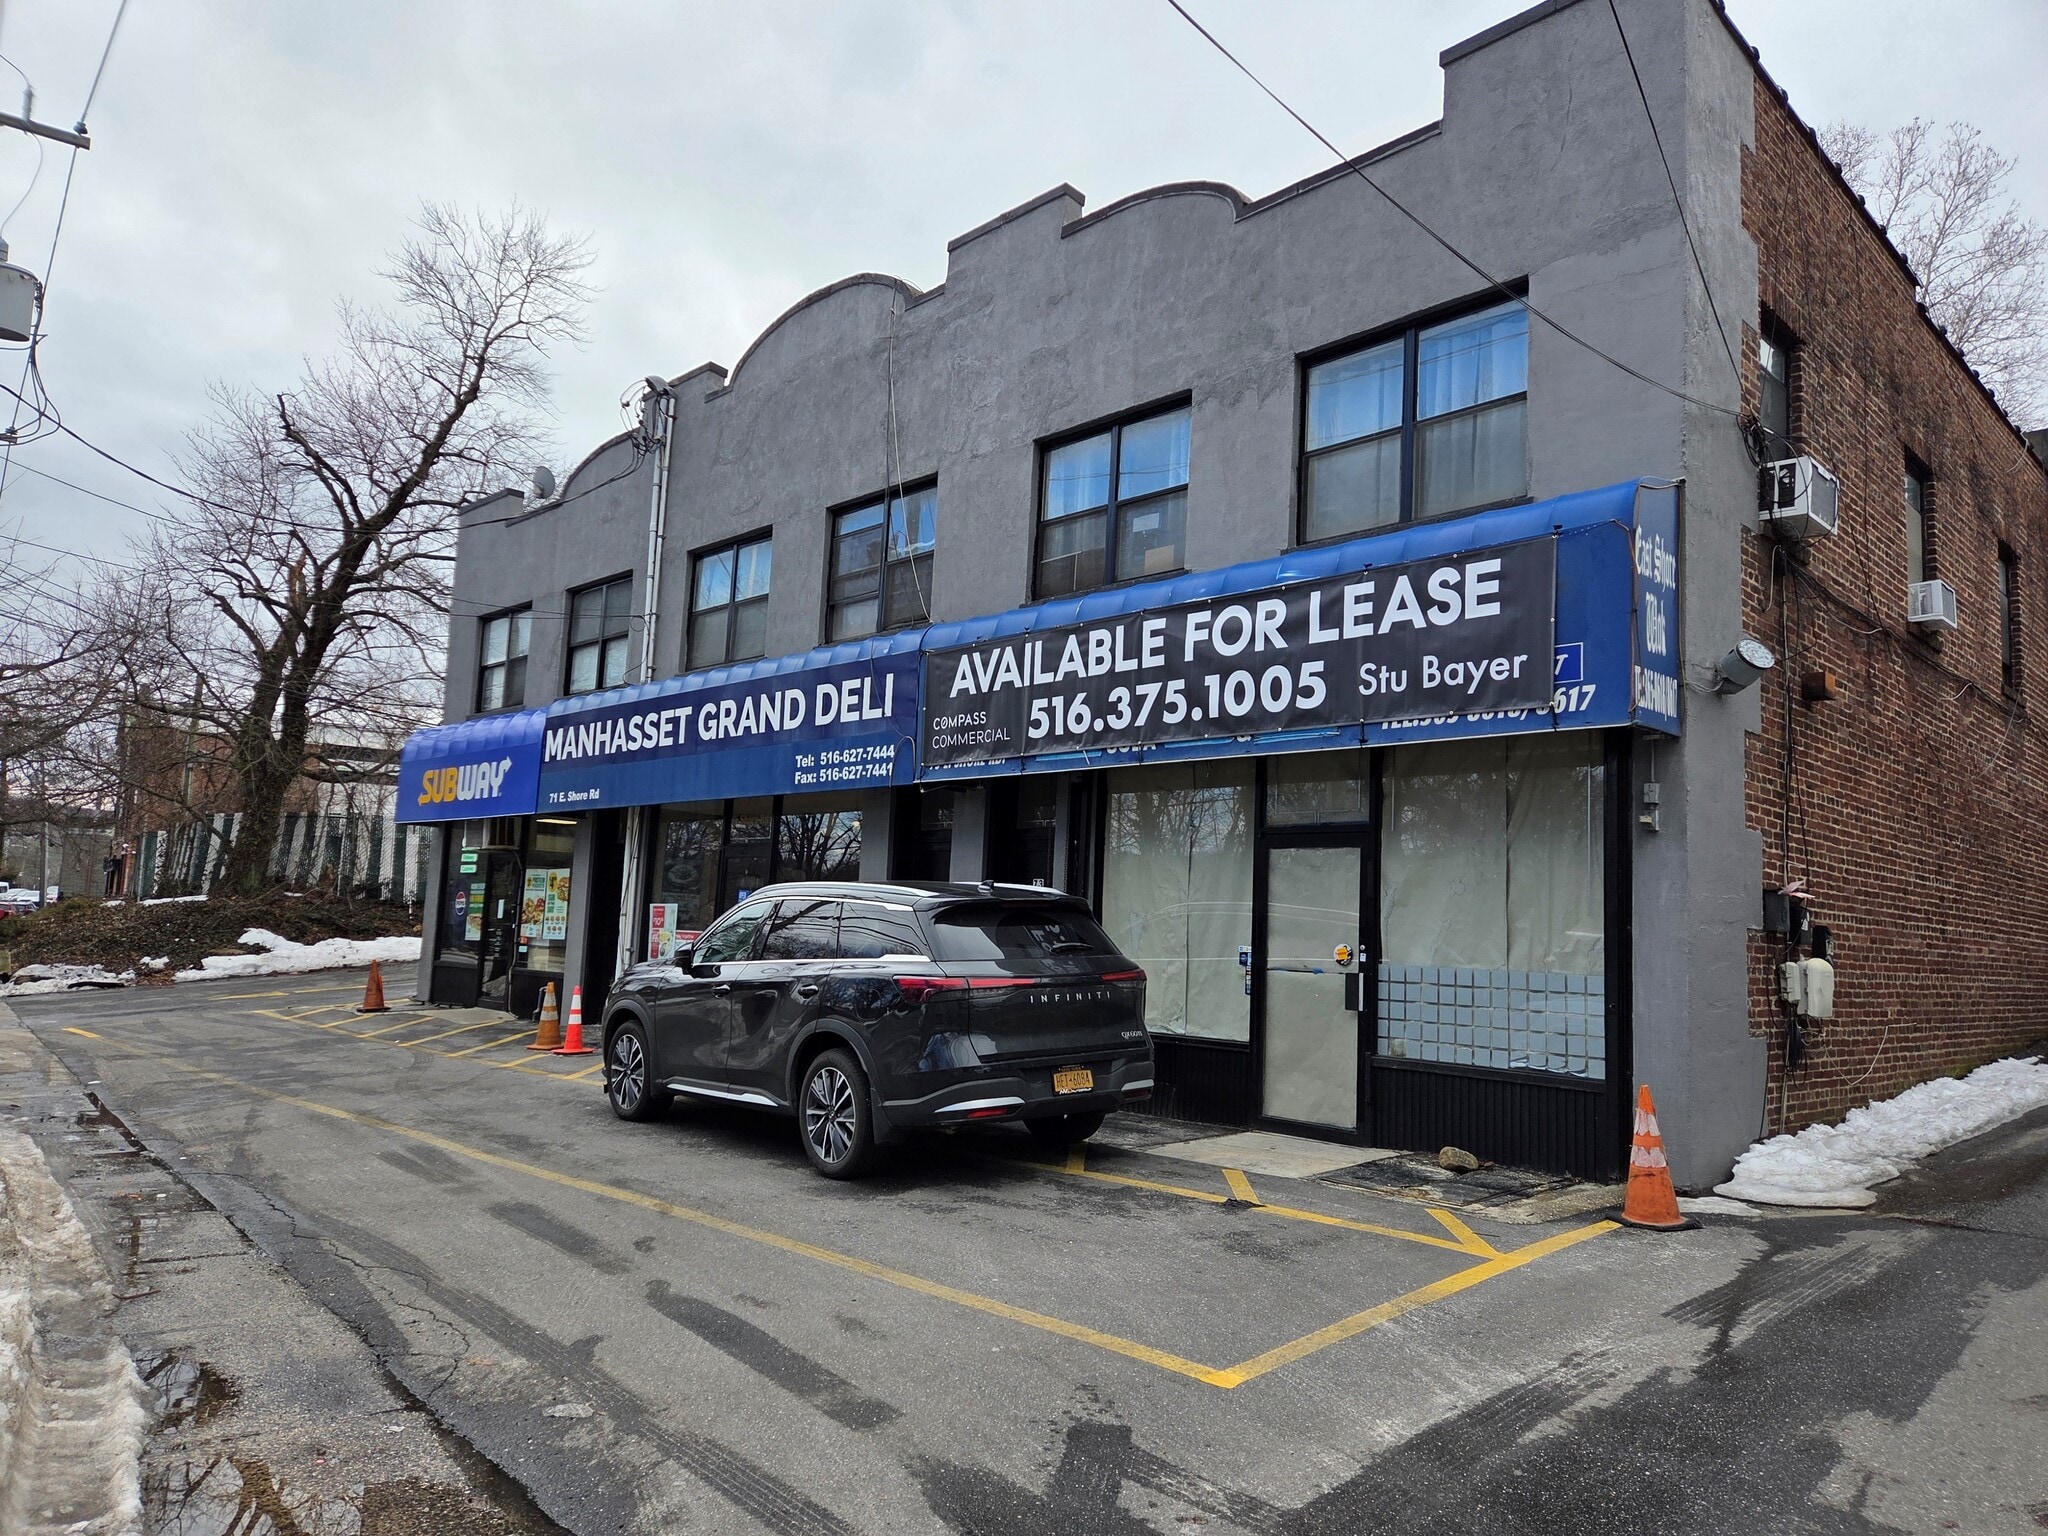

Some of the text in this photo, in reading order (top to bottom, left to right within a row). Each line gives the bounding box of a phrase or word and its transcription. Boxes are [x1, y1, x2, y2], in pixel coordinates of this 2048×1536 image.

[1635, 524, 1653, 579] East
[949, 558, 1502, 700] AVAILABLE FOR LEASE
[1027, 654, 1528, 739] 516.375.1005 Stu Bayer
[543, 672, 894, 763] MANHASSET GRAND DELI
[932, 711, 988, 731] COMPASS
[931, 728, 1011, 749] COMMERCIAL
[796, 744, 895, 768] Tel: 516-627-7444
[417, 755, 513, 807] SUBWAY
[795, 762, 893, 785] Fax: 516-627-7441
[549, 793, 558, 804] 71
[567, 791, 588, 802] Shore
[589, 788, 600, 800] Rd
[1030, 991, 1111, 1004] INFINITI
